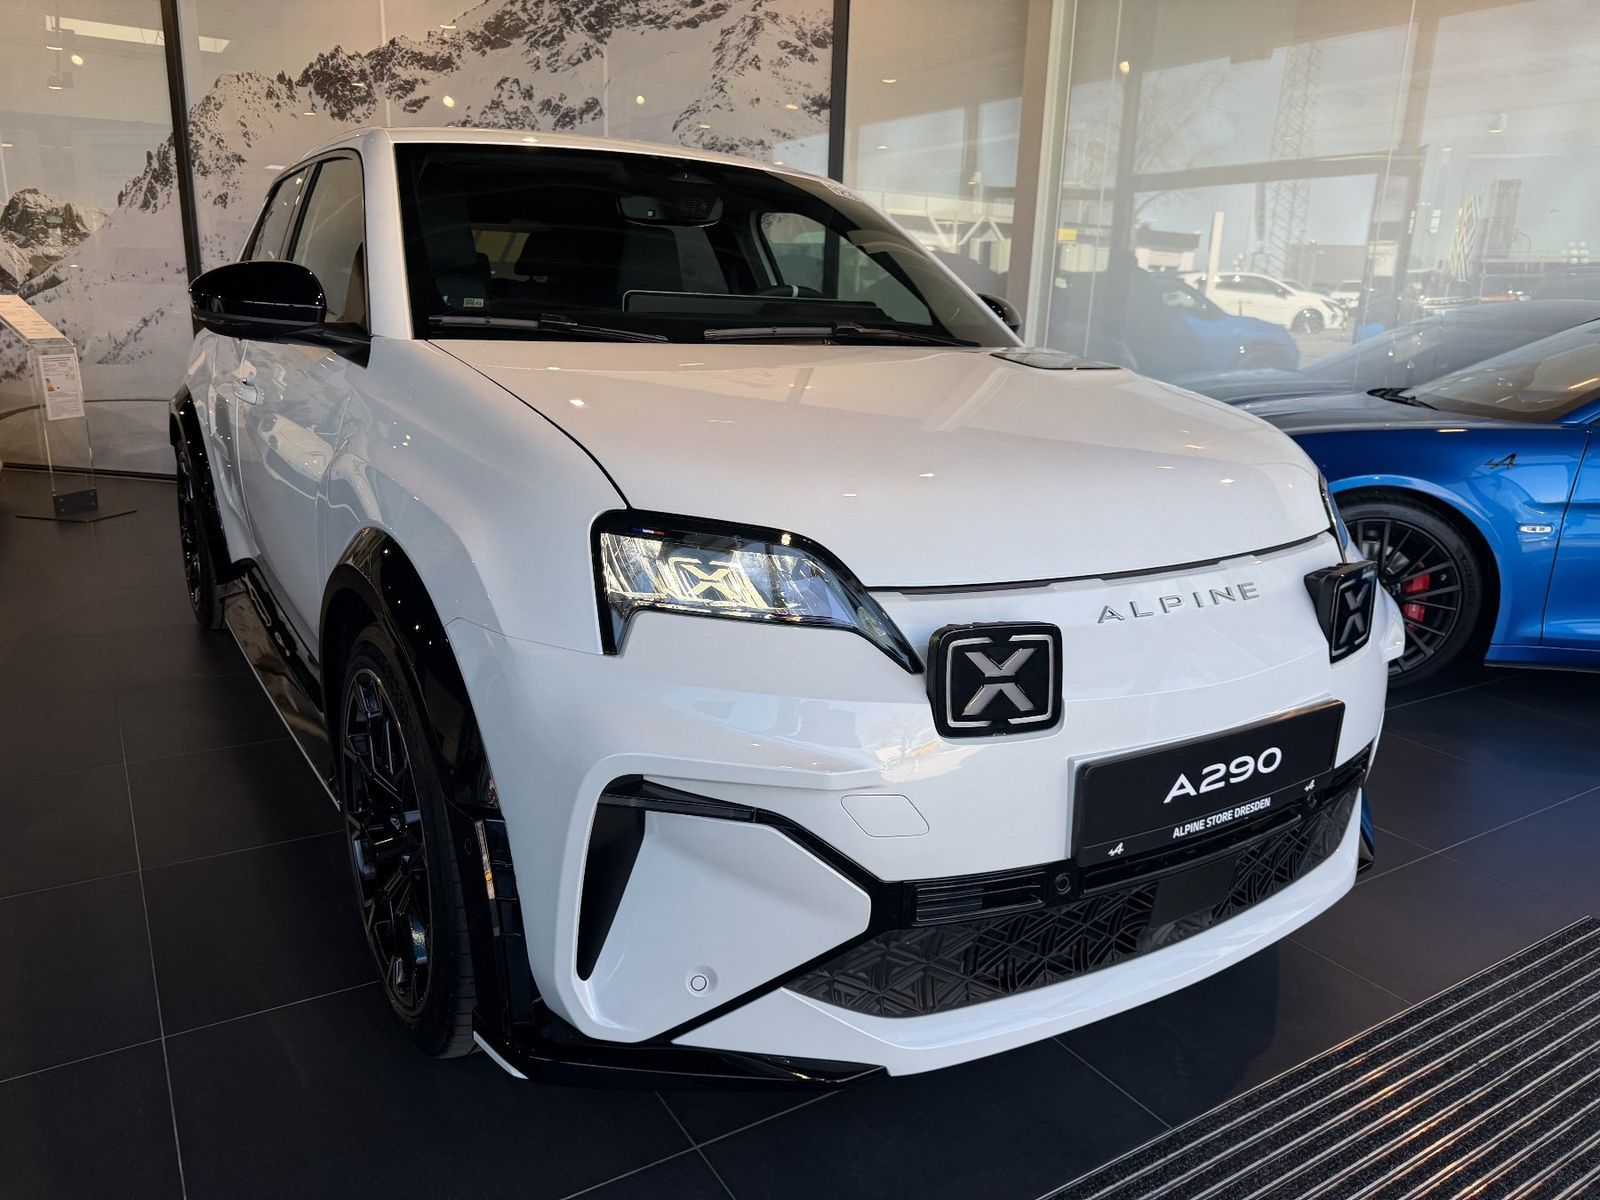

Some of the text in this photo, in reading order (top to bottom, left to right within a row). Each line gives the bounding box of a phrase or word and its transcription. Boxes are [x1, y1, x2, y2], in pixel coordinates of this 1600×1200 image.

[1097, 581, 1260, 624] ALPINE
[1163, 747, 1282, 804] A290
[1172, 797, 1271, 838] ALPINE STORE DRESDEN
